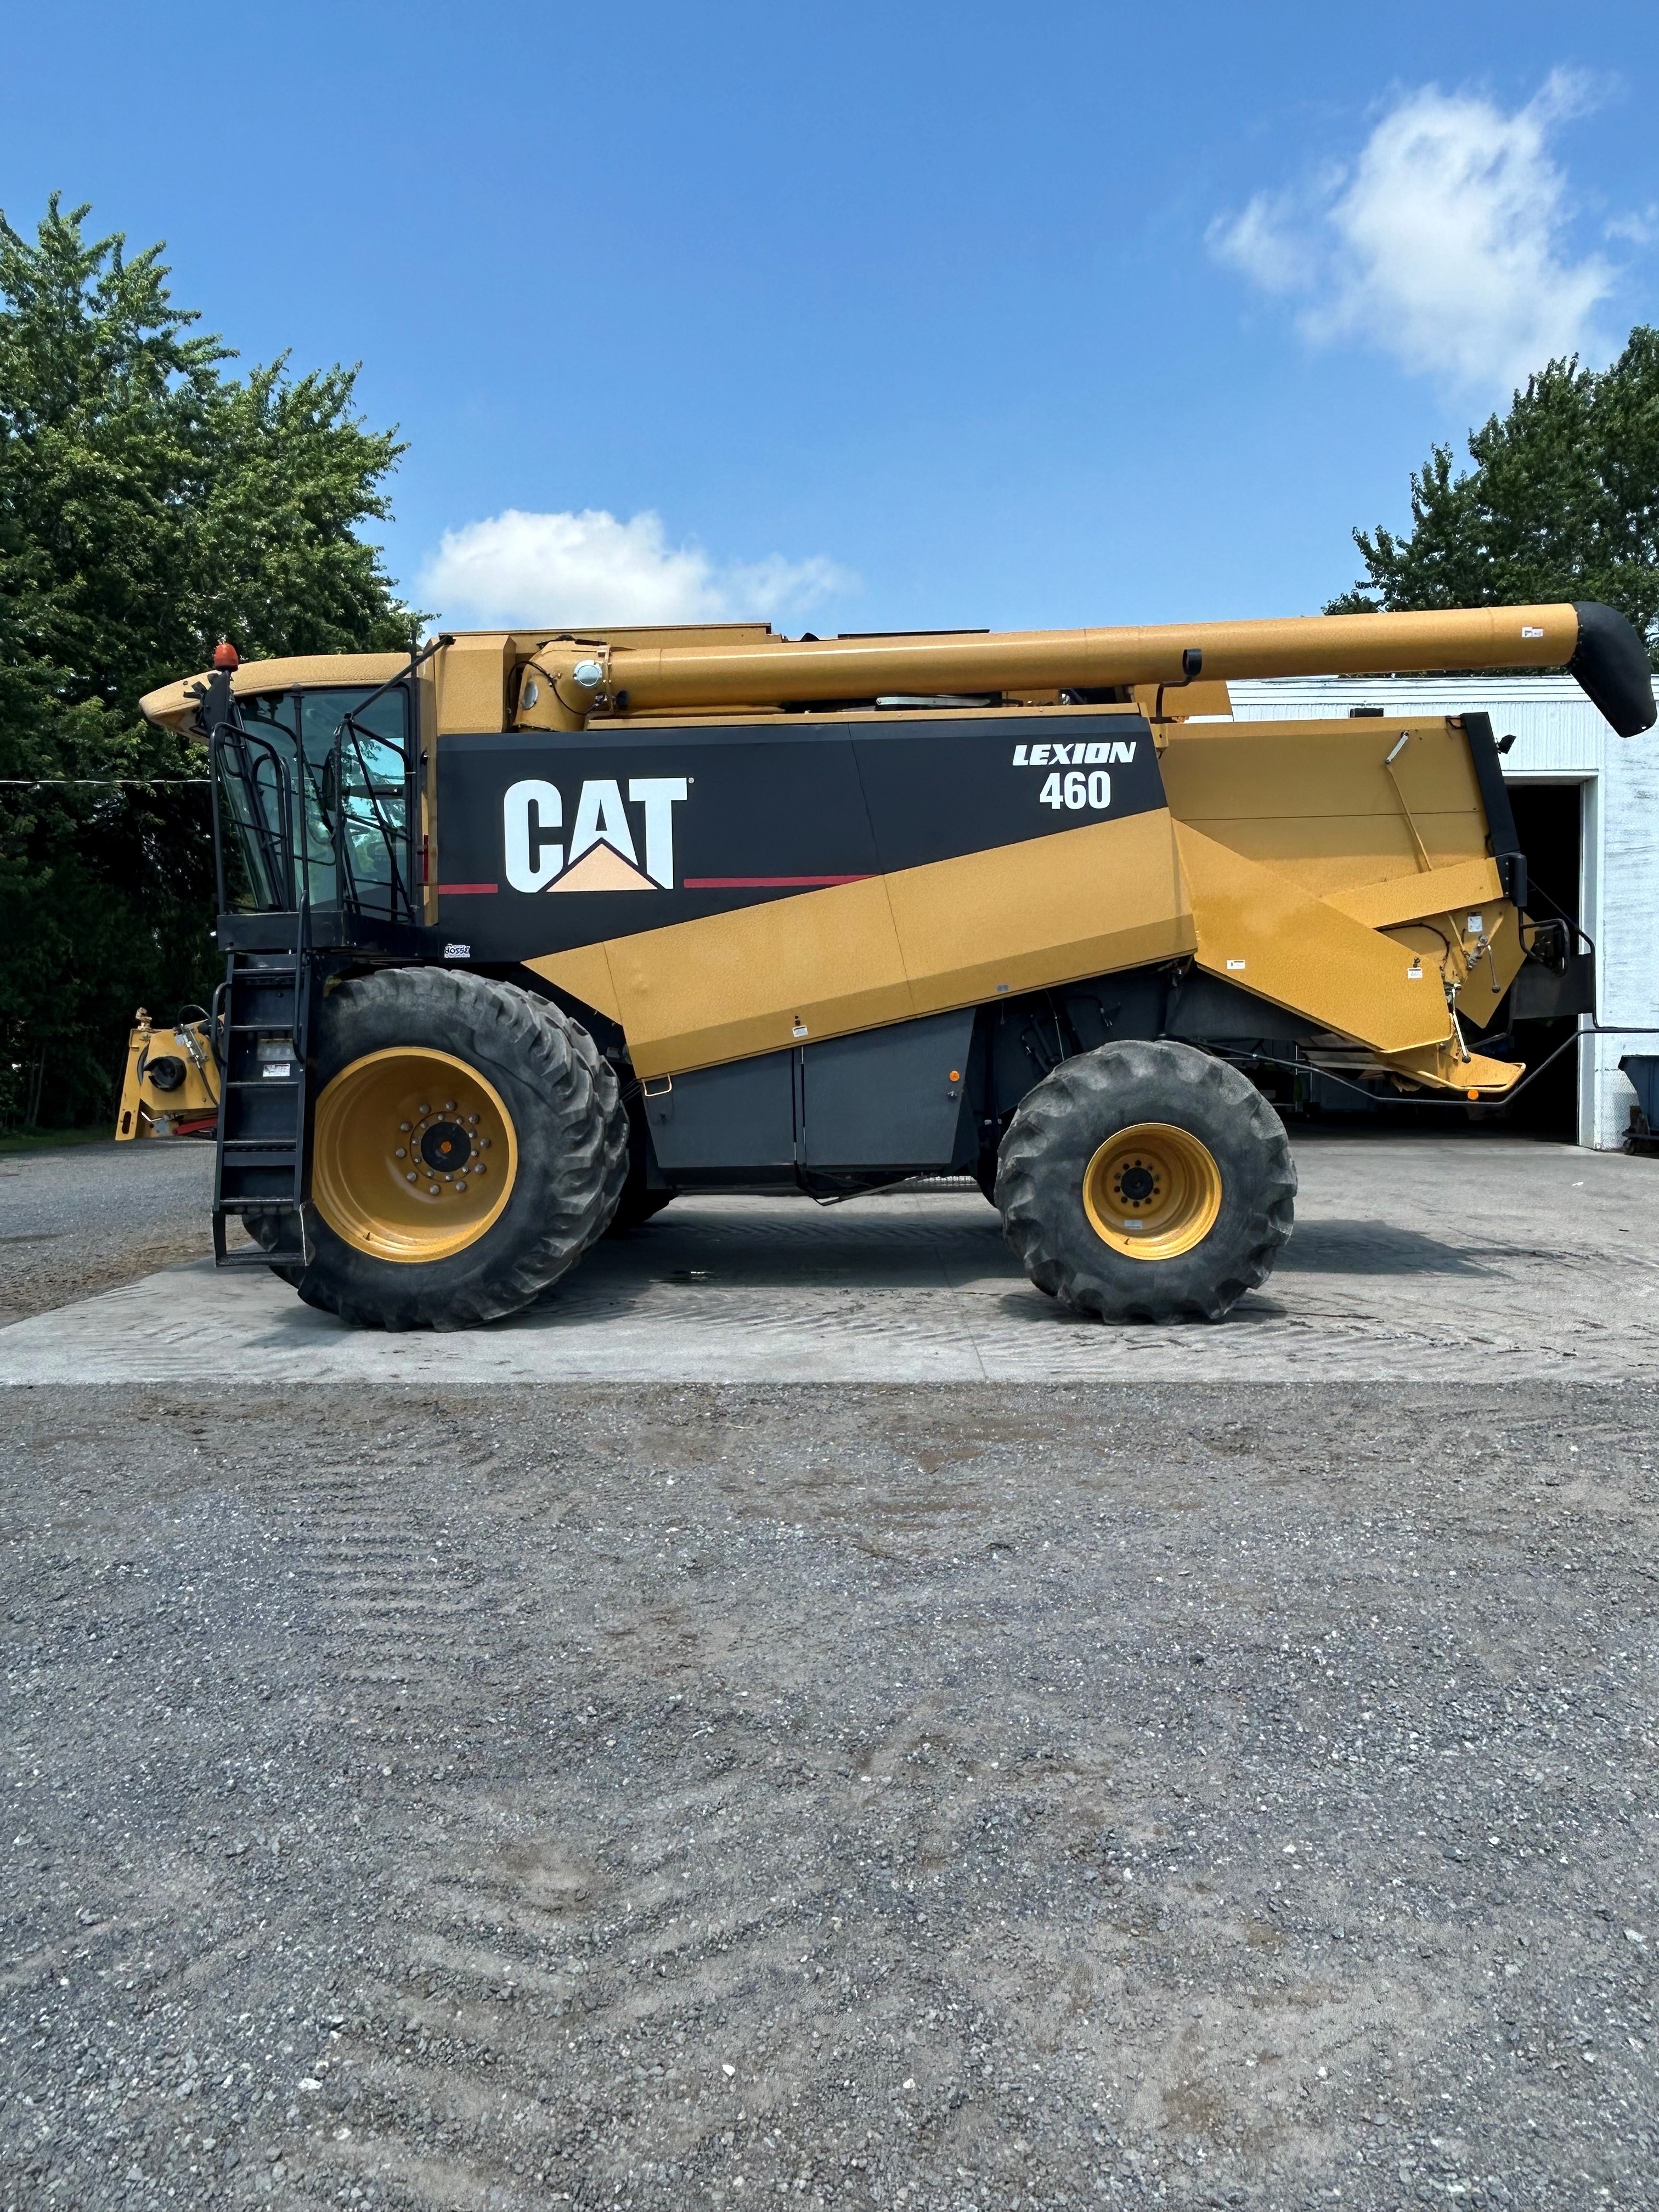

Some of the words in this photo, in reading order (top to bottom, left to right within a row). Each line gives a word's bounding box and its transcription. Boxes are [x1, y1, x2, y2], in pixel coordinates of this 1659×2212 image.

[1012, 741, 1137, 766] LEXION
[1039, 770, 1111, 810] 460
[504, 777, 687, 893] CAT
